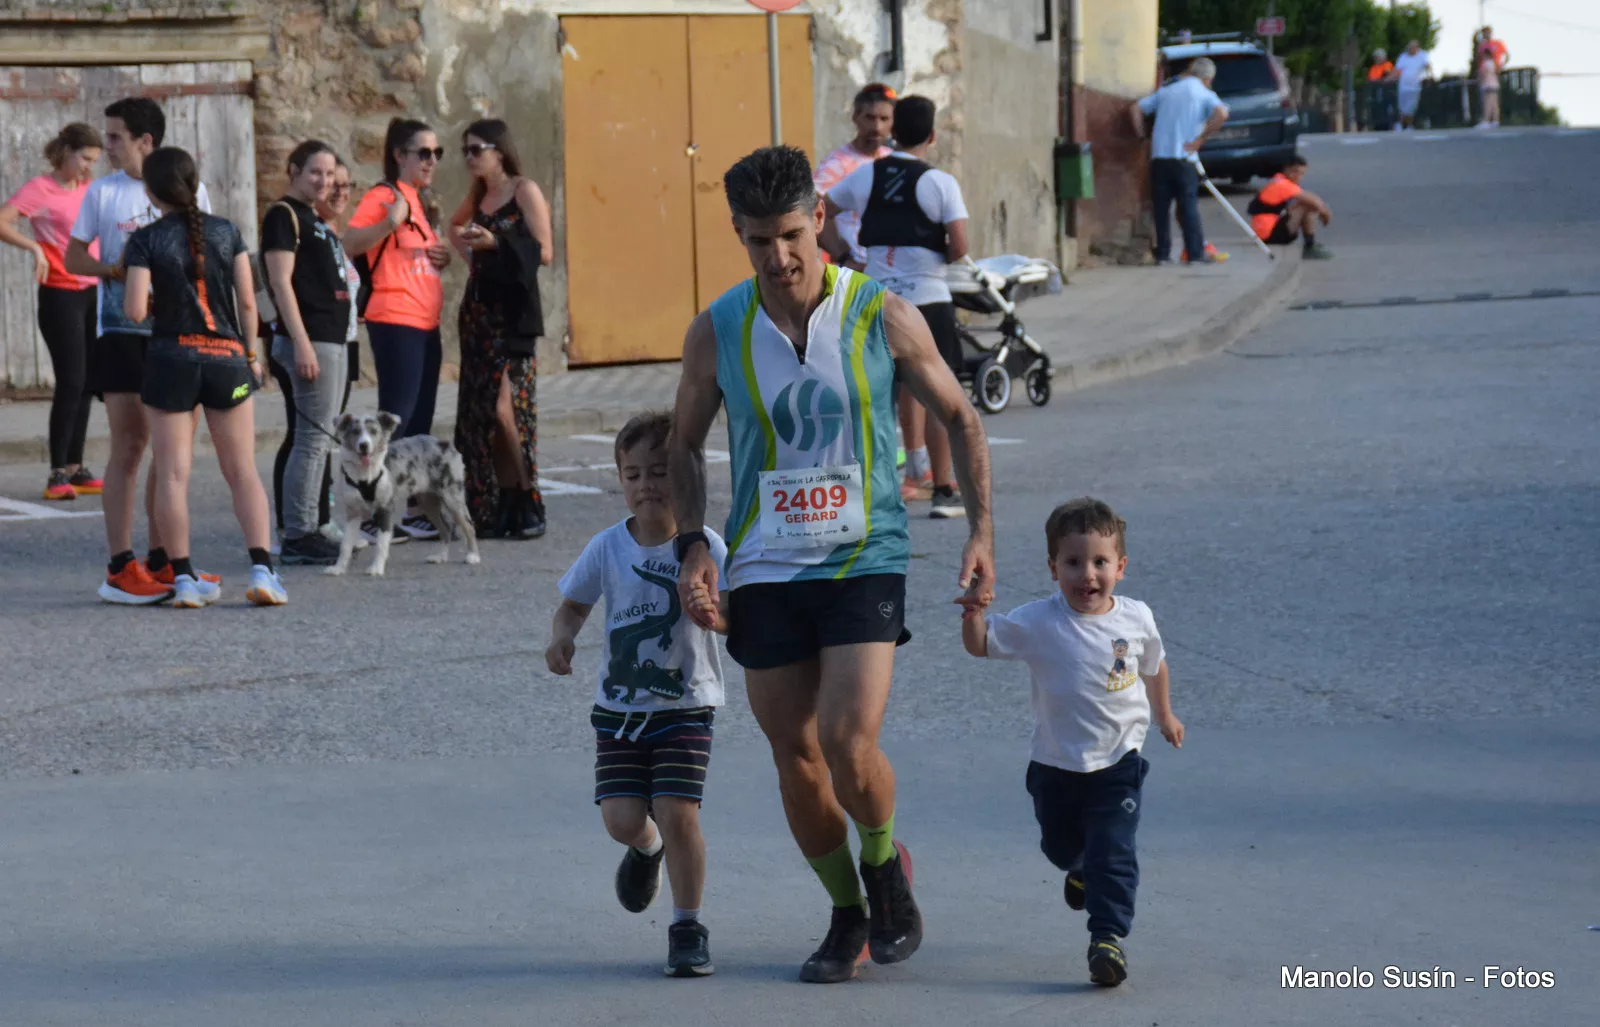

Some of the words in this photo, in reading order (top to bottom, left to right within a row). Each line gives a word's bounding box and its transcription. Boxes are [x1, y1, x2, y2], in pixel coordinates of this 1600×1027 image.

[772, 485, 847, 512] 2409
[785, 511, 838, 524] GERARD
[641, 559, 679, 578] ALWA
[613, 601, 659, 624] HUNGRY
